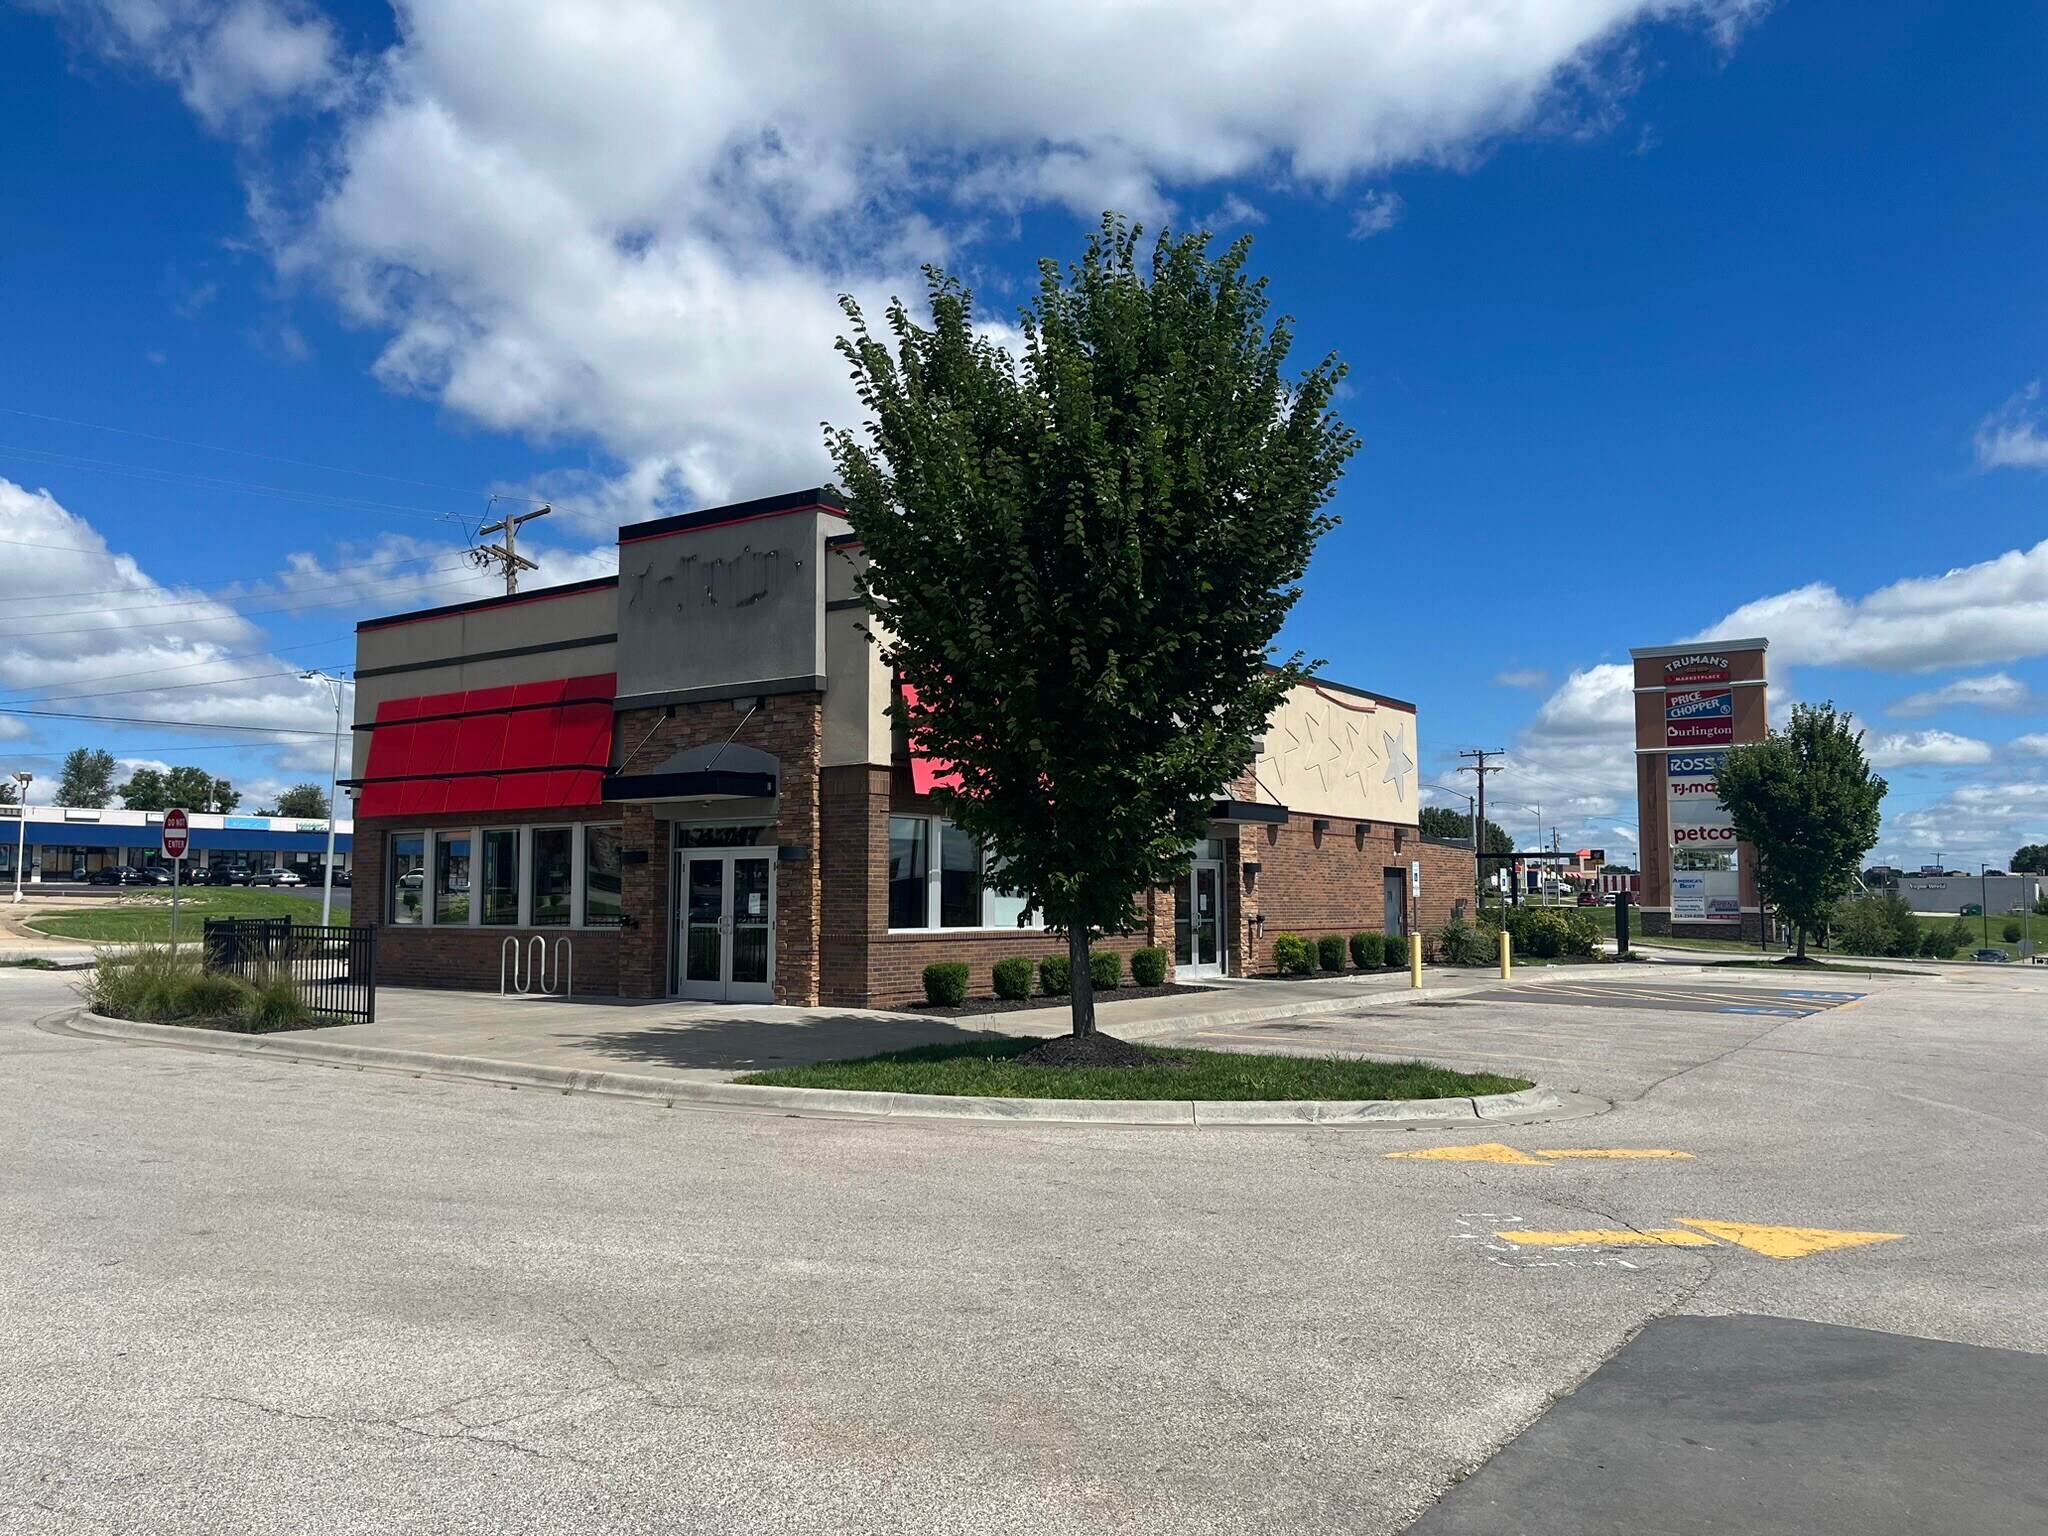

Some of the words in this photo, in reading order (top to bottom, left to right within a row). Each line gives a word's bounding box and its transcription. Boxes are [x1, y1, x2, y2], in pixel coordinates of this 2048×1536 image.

[1665, 655, 1729, 672] TRUMAN'S
[1671, 691, 1702, 706] PRICE
[1671, 699, 1720, 718] CHOPPER
[1667, 726, 1732, 738] Burlington
[1670, 757, 1715, 771] ROSS
[168, 818, 175, 826] DO
[176, 818, 185, 827] NOT
[1674, 826, 1733, 844] petco
[168, 840, 184, 848] ENTER
